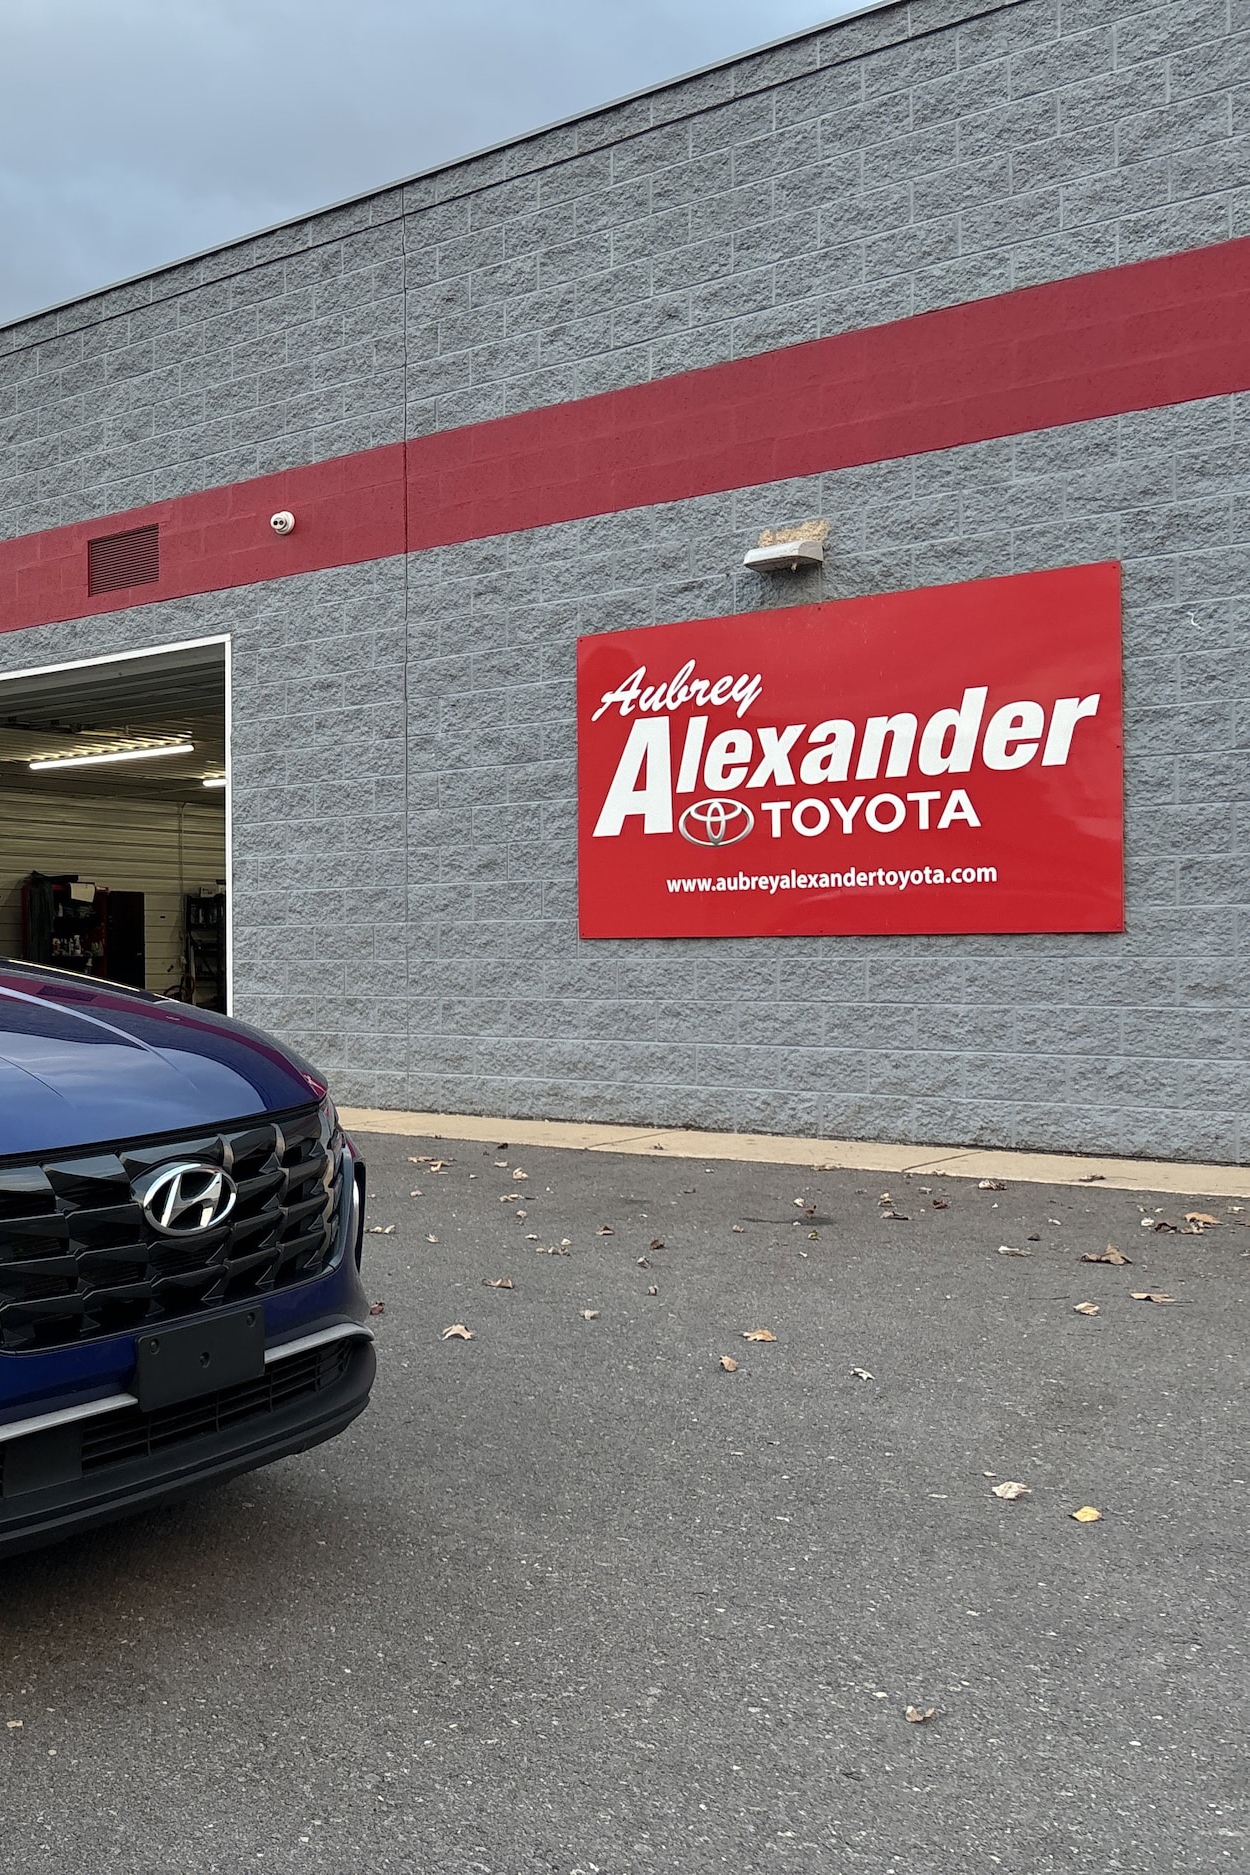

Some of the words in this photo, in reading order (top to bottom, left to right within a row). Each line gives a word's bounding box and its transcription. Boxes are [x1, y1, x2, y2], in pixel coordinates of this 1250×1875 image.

[591, 659, 763, 722] Aubrey
[592, 685, 1101, 838] Alexander
[760, 789, 982, 838] TOYOTA
[666, 866, 998, 895] www.aubreyalexandertoyota.com
